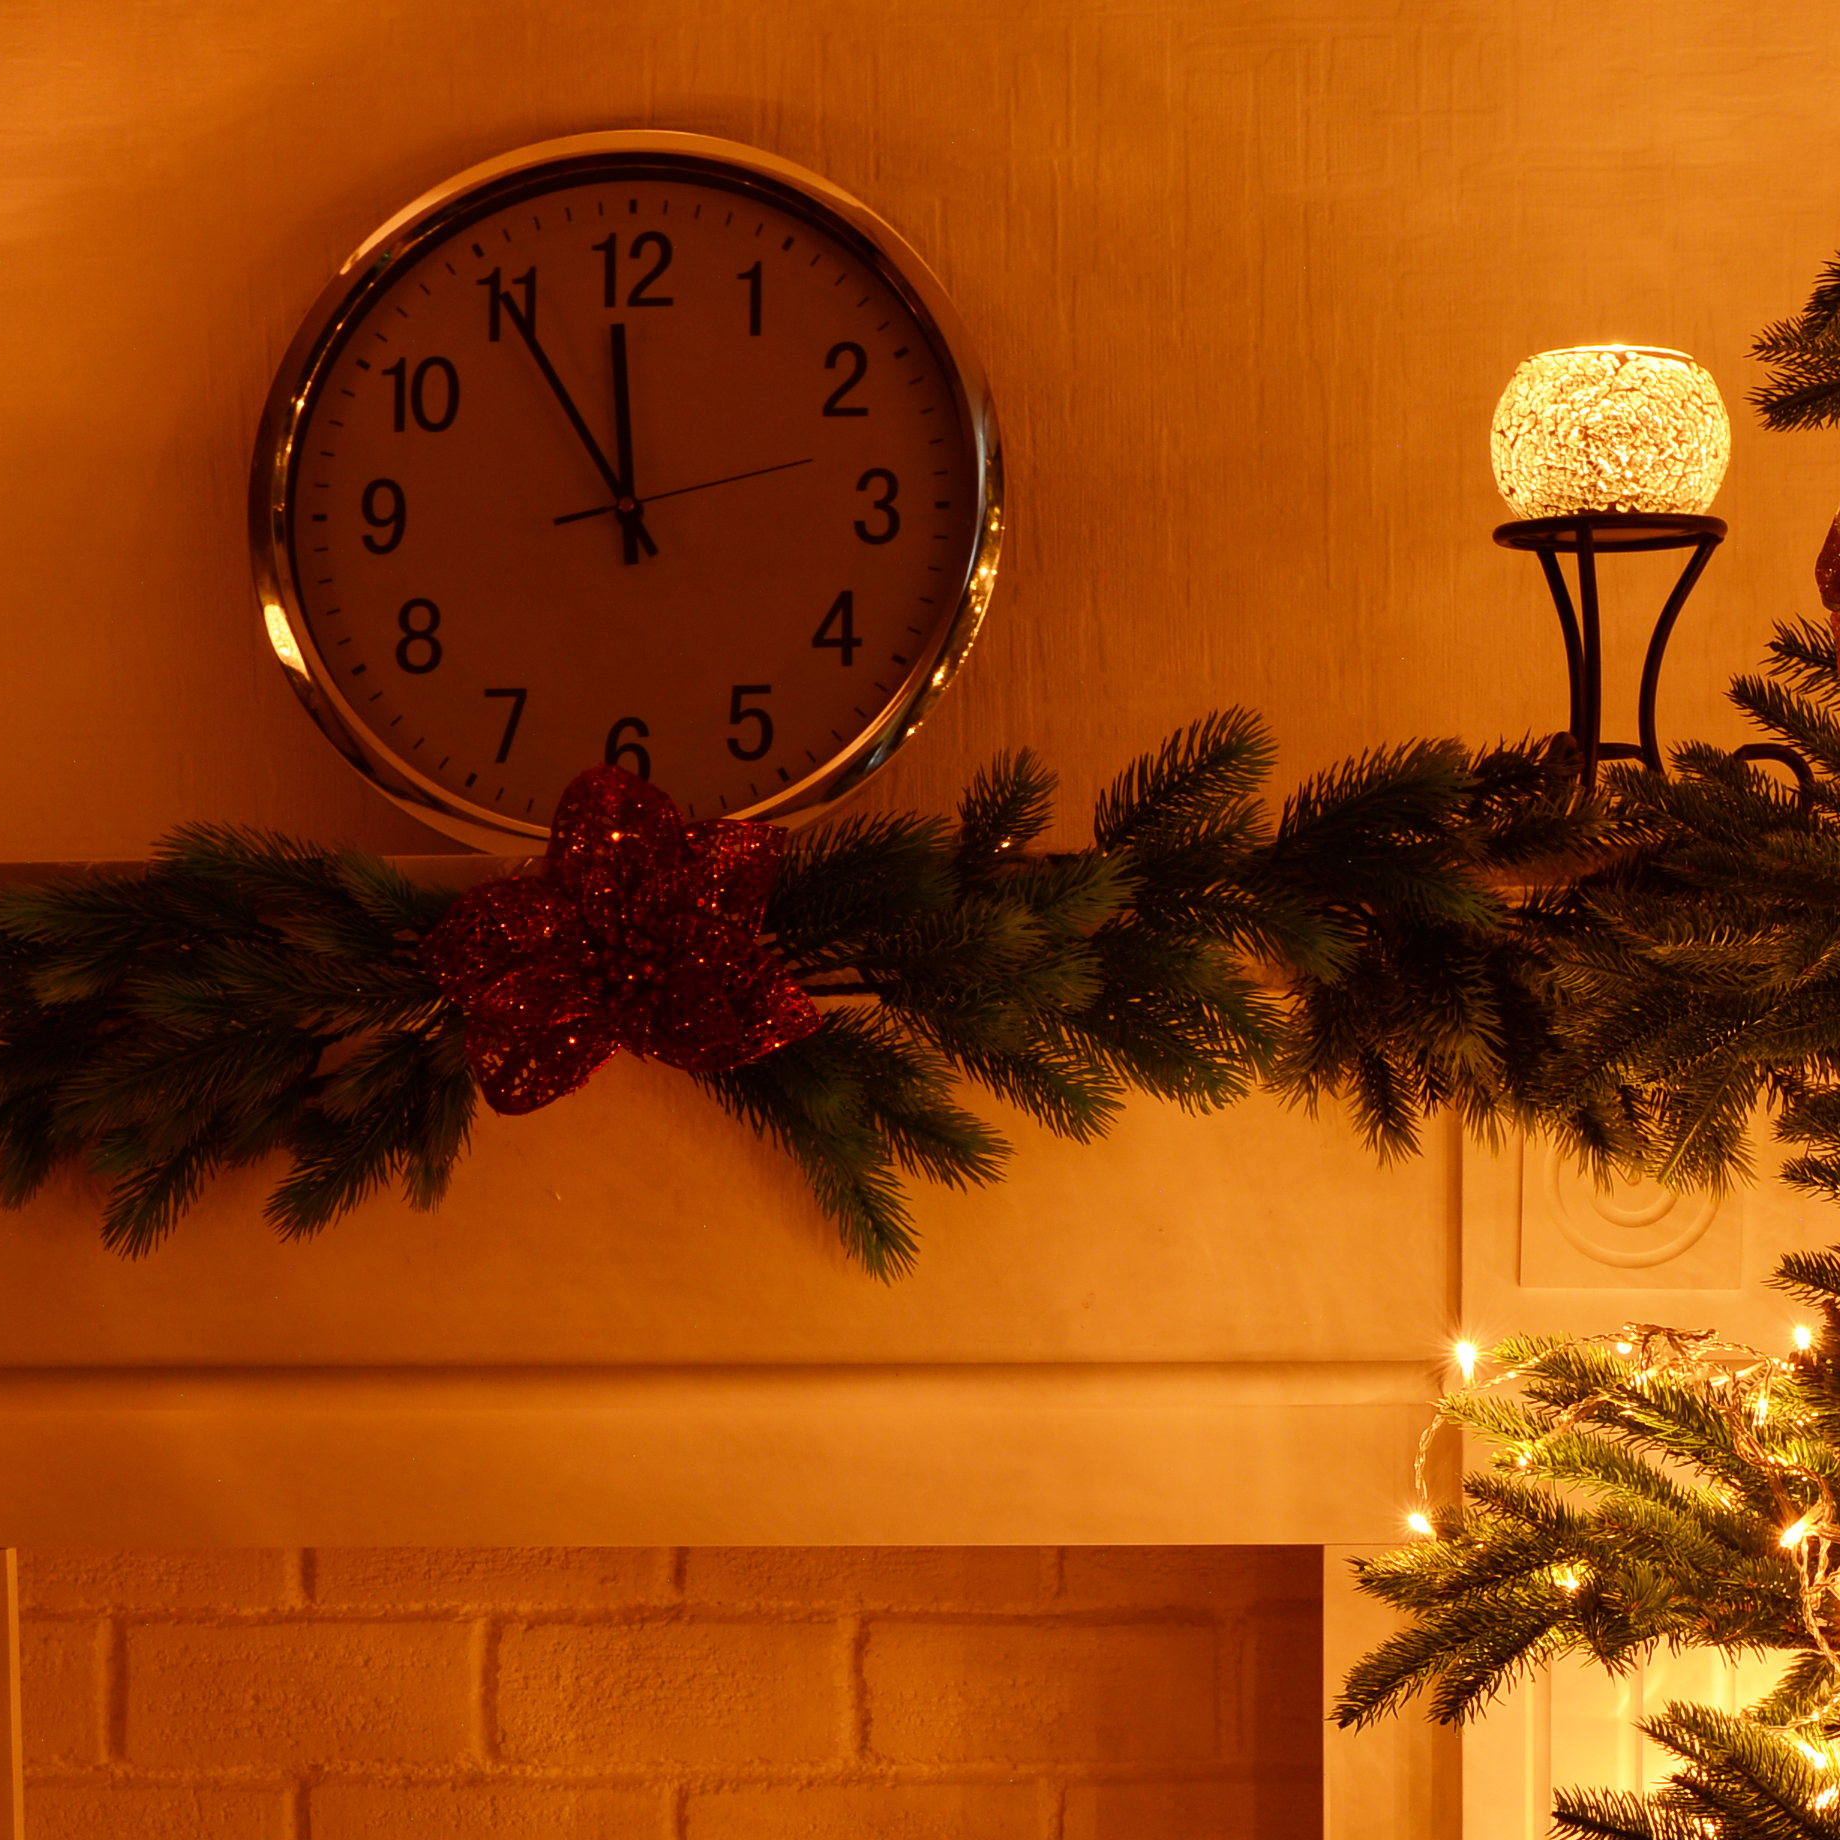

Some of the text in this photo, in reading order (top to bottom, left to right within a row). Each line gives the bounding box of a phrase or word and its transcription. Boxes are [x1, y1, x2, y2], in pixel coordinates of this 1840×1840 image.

[476, 266, 538, 343] 11
[592, 231, 674, 308] 12
[737, 261, 763, 337] 1
[381, 356, 461, 433] 10
[822, 342, 869, 418] 2
[361, 478, 407, 555] 9
[853, 468, 901, 545] 3
[395, 598, 443, 675] 8
[811, 590, 863, 667] 4
[484, 688, 528, 764] 7
[726, 685, 774, 762] 5
